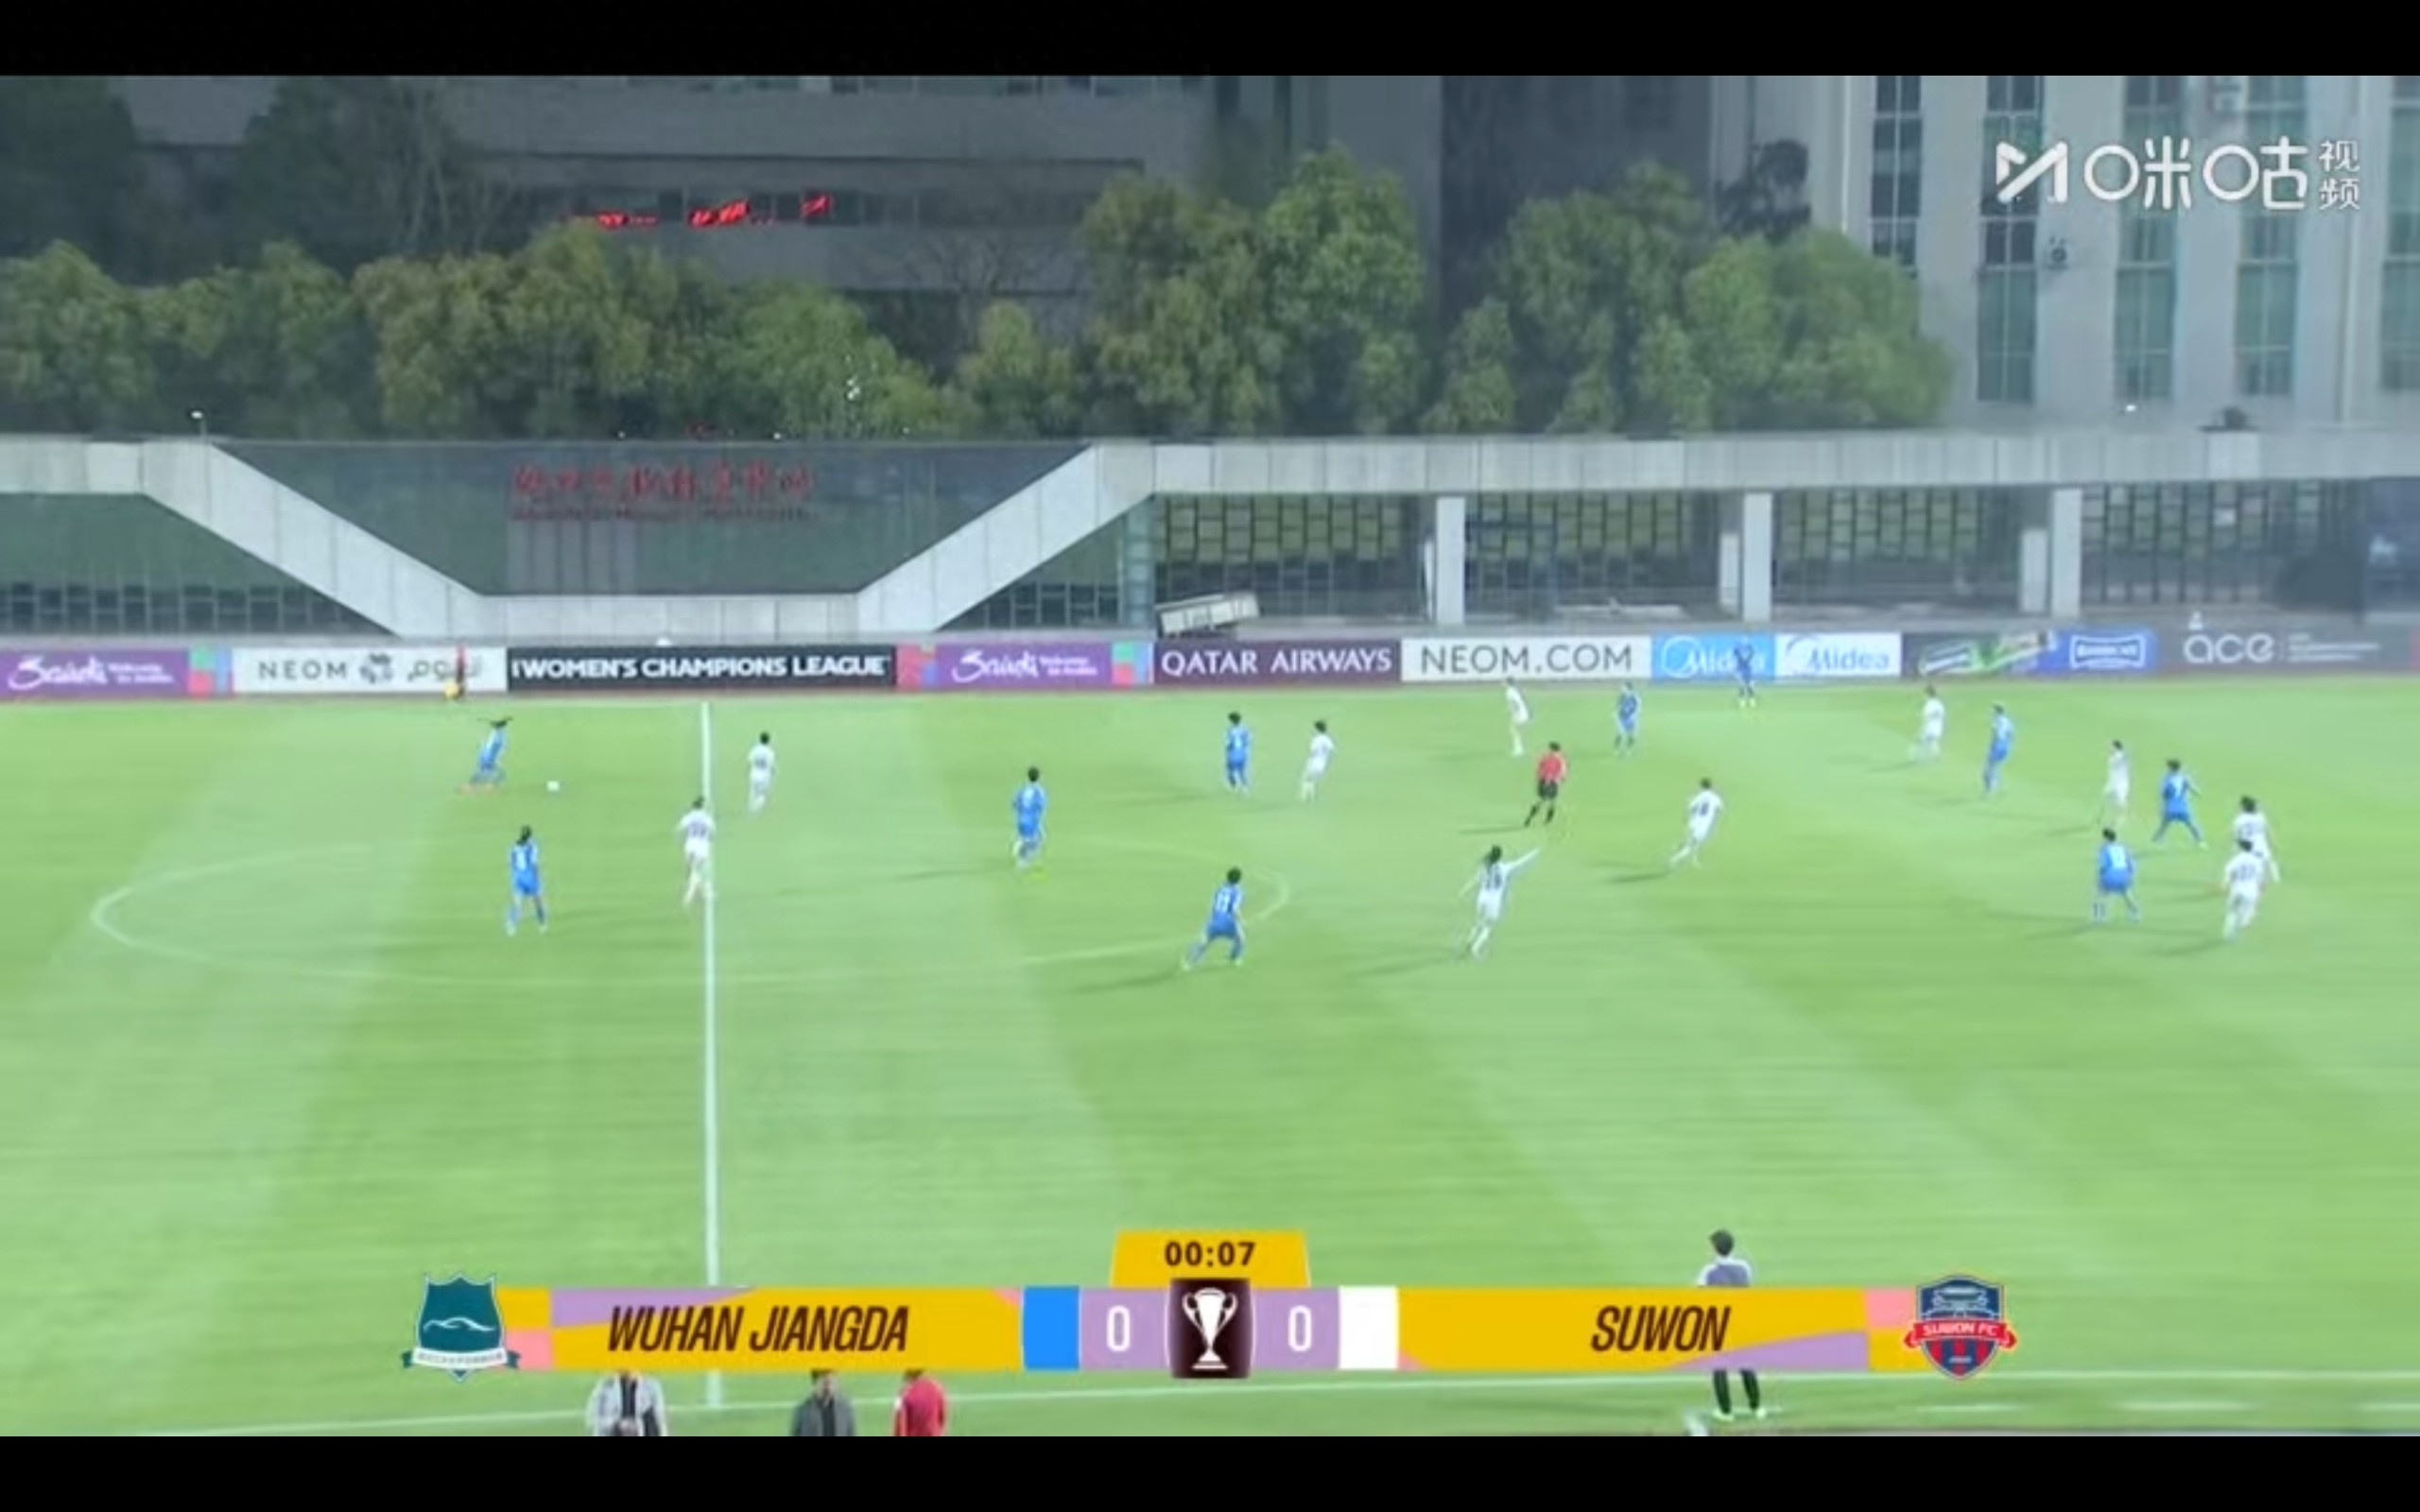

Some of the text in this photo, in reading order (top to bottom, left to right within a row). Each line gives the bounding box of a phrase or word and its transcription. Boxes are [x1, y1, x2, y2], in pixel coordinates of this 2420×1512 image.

[1161, 647, 1392, 678] QATAR AIRWAYS
[1421, 644, 1632, 675] NEOM.COM
[1806, 644, 1890, 673] Midea
[2183, 632, 2275, 663] ace
[259, 660, 347, 679] NEOM
[642, 655, 786, 678] CHAMPIONS
[792, 654, 886, 676] LEAGUE
